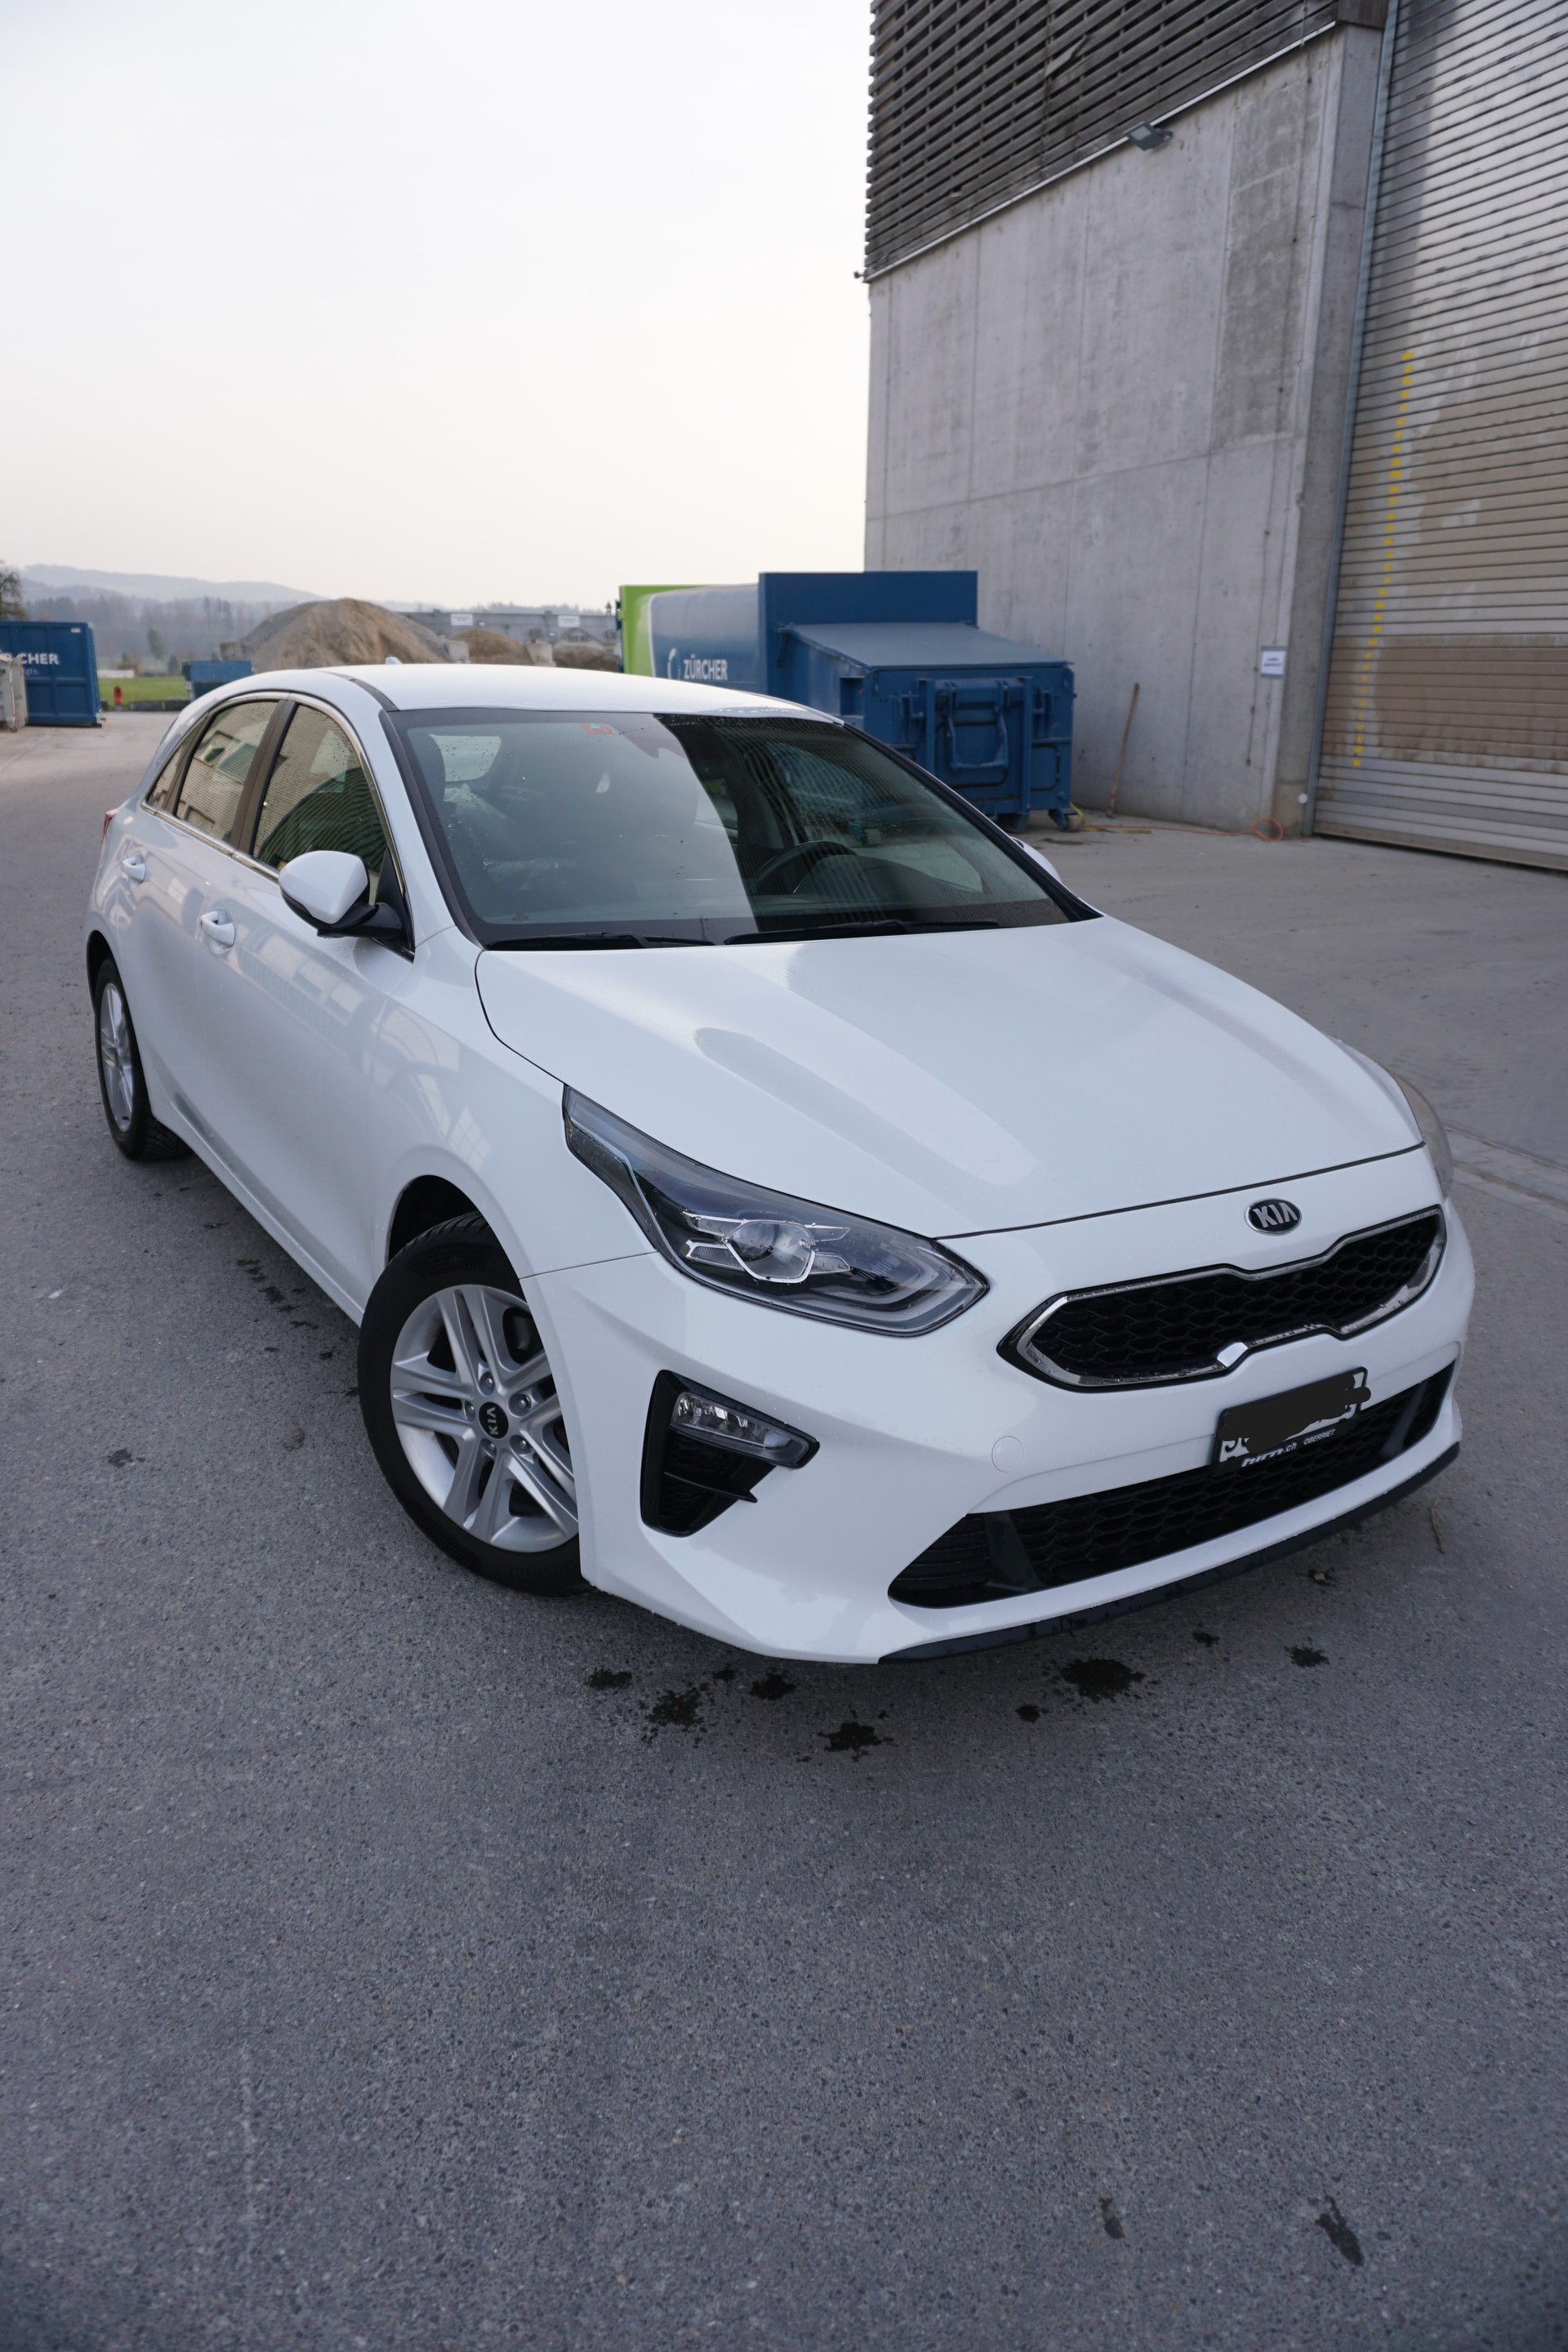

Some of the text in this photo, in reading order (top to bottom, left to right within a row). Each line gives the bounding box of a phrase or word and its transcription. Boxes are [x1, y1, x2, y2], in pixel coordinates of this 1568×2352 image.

[683, 653, 728, 680] ZÜRCHER
[1252, 1202, 1298, 1228] KIA
[486, 1406, 499, 1436] KIA
[1303, 1428, 1336, 1446] OBERRIET
